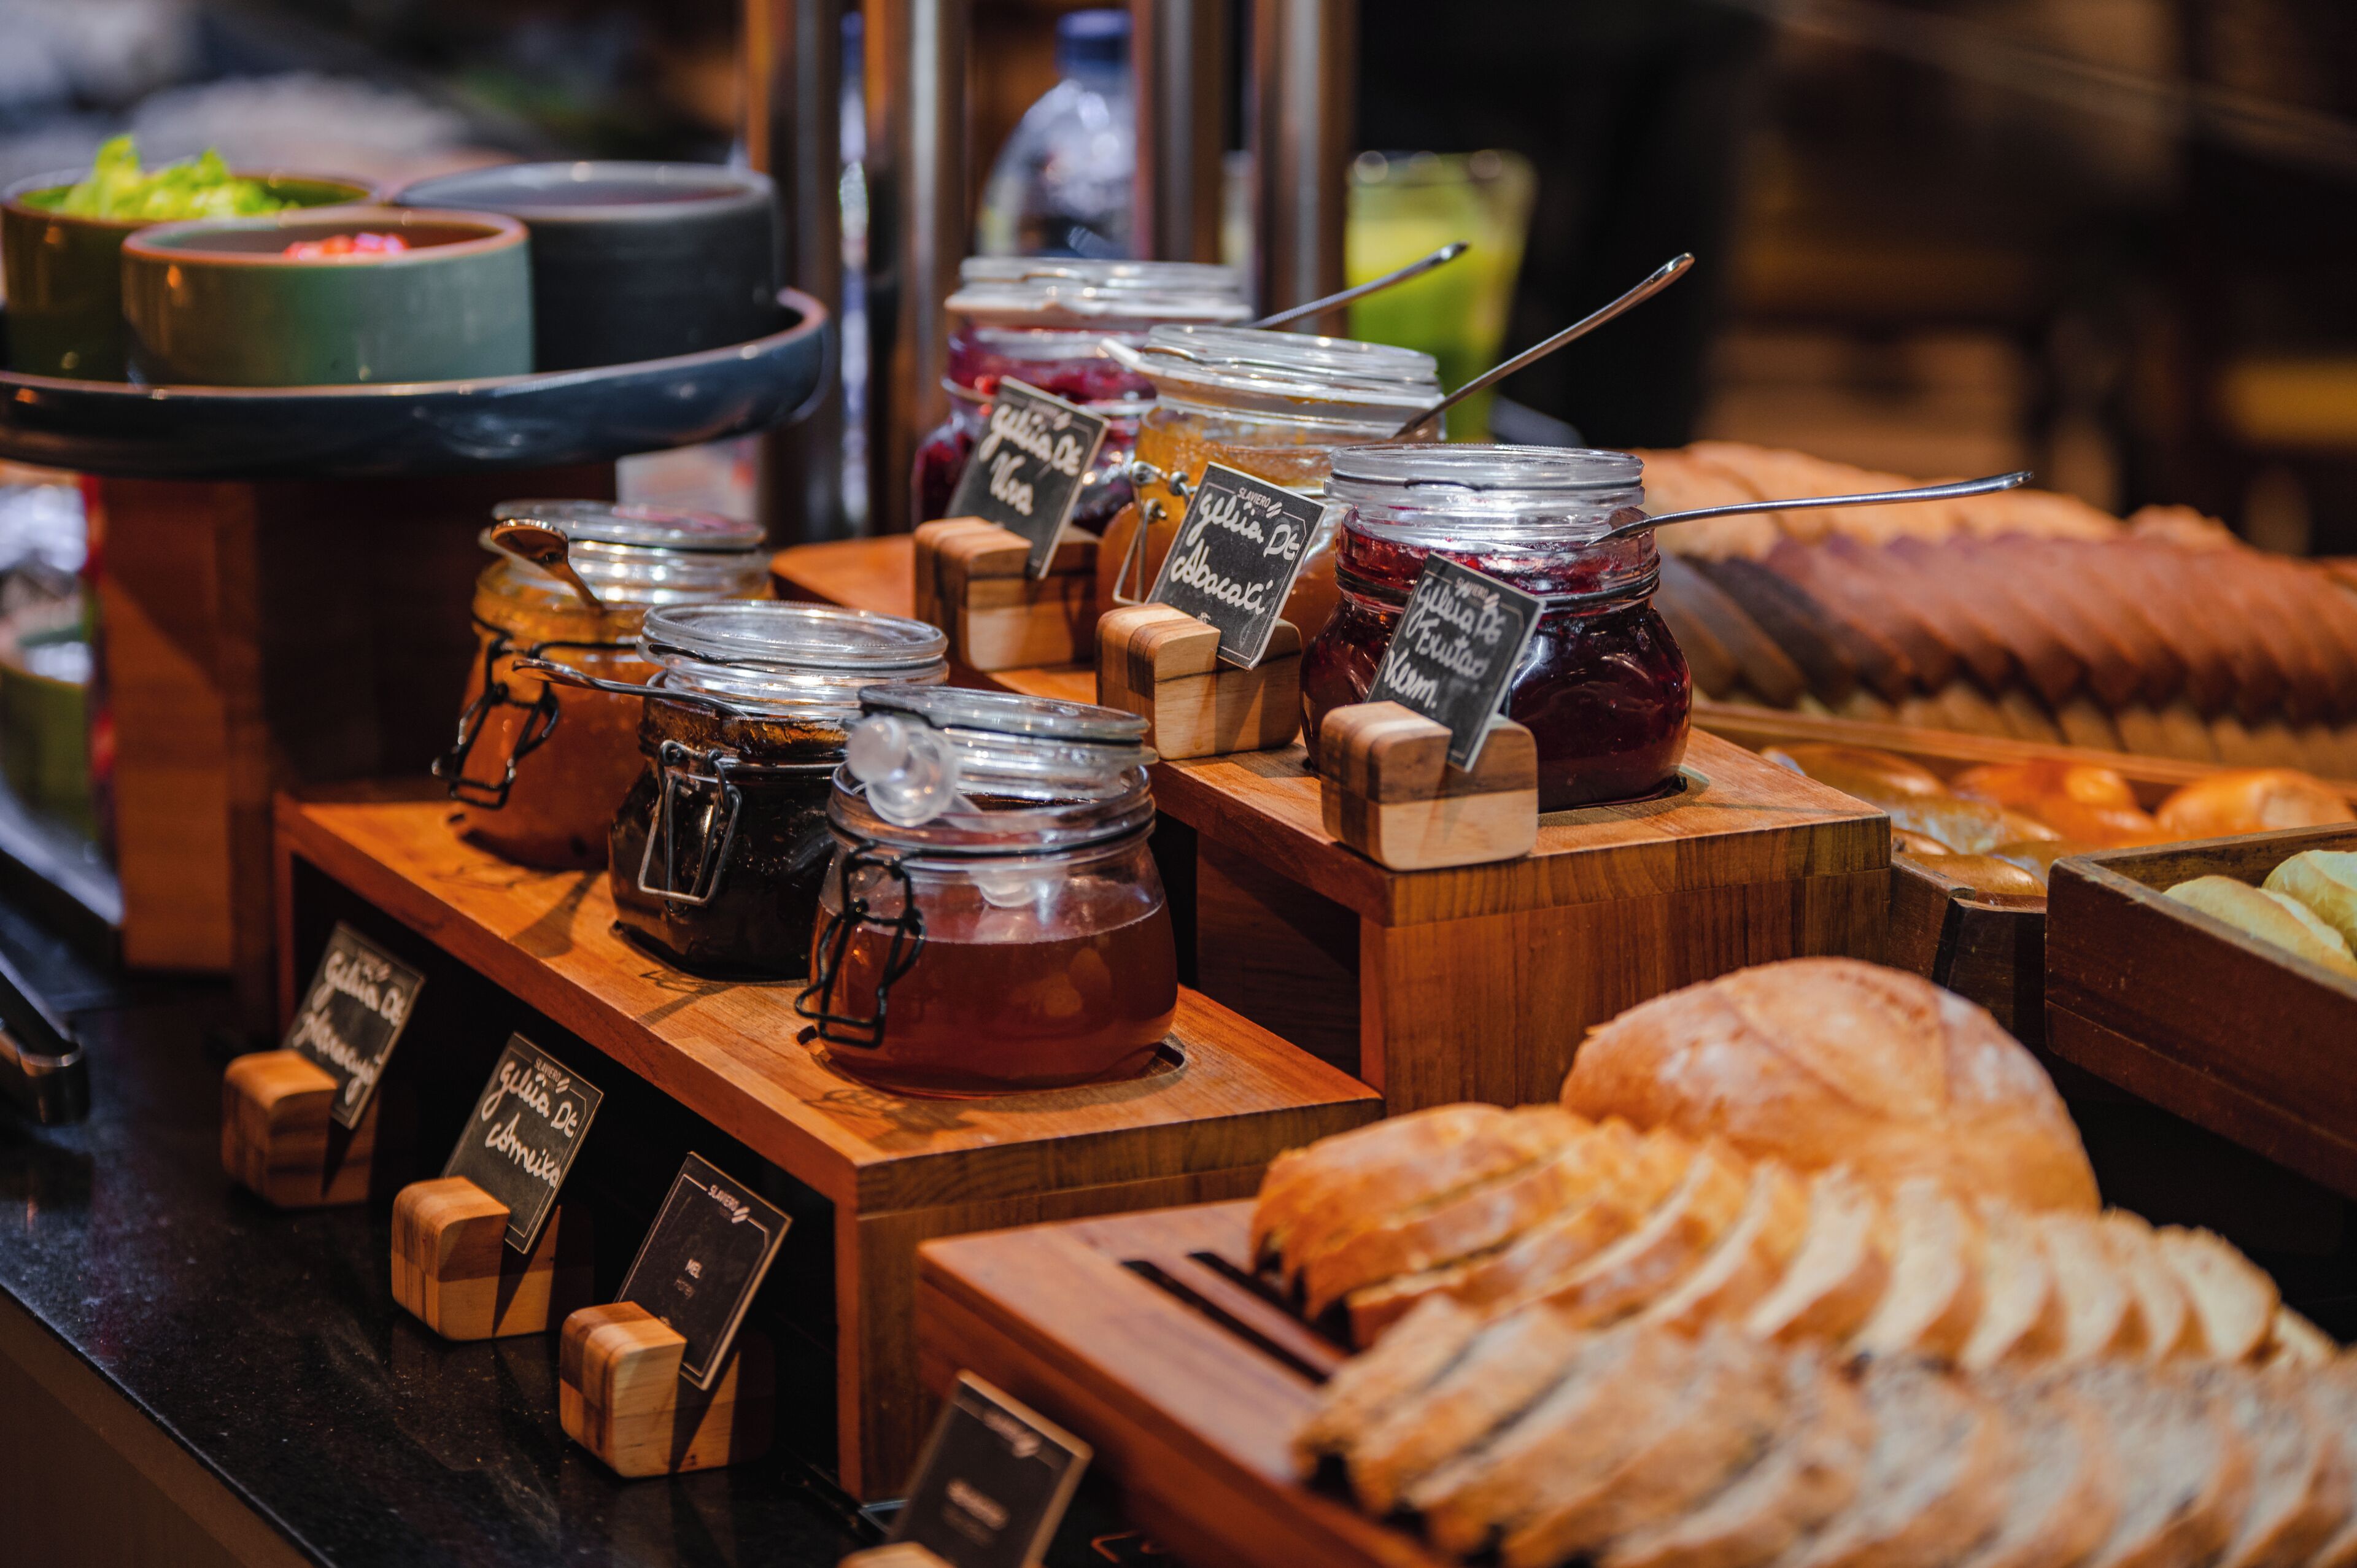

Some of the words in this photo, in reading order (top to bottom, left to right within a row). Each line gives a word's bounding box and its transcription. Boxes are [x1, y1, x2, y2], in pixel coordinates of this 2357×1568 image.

[1237, 487, 1271, 508] SLAVIERO
[1170, 538, 1274, 615] Abacaxi
[534, 1056, 561, 1083] SLAVIERO
[708, 1184, 740, 1212] SLAVIERO
[685, 1258, 702, 1279] MEL
